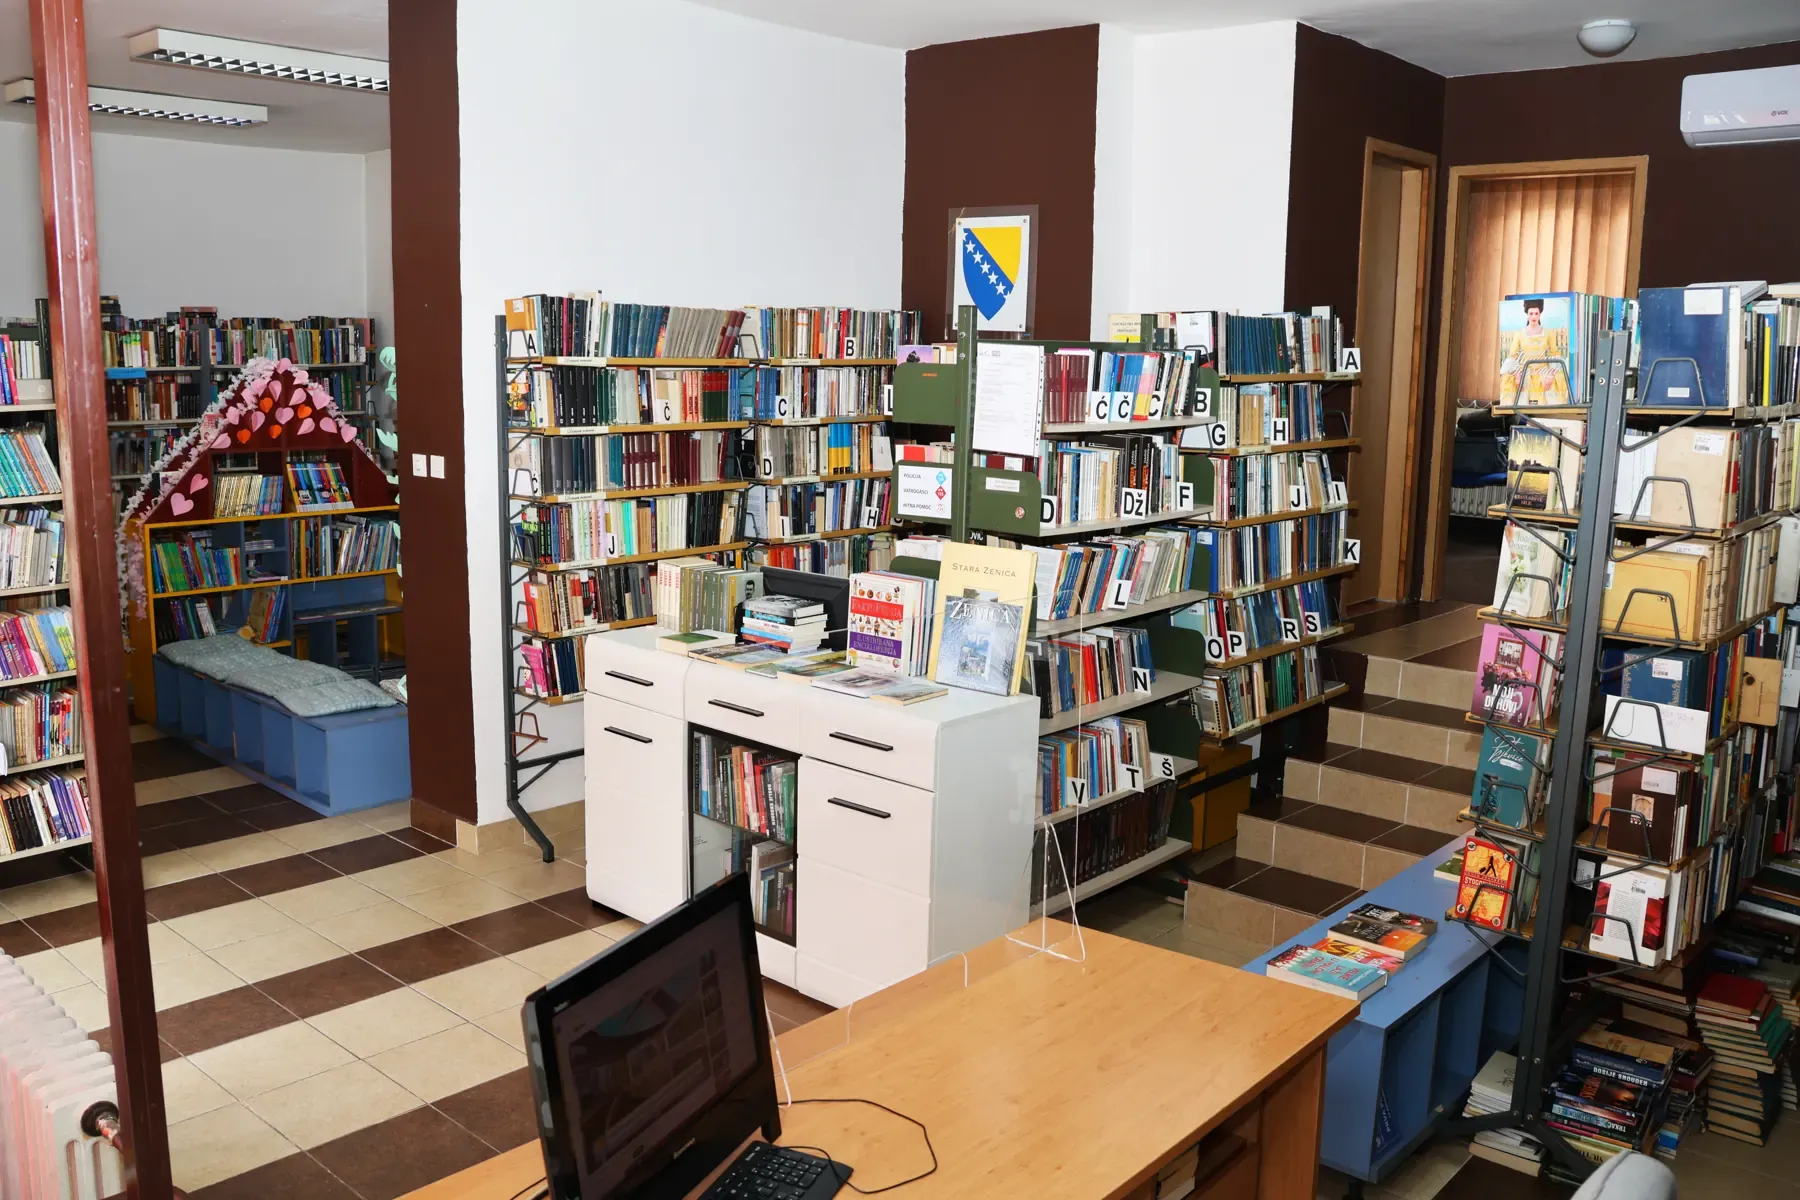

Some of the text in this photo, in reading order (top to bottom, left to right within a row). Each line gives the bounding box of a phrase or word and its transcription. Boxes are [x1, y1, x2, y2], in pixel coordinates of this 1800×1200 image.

[528, 333, 537, 354] A
[846, 340, 854, 356] B
[1344, 350, 1359, 370] A
[664, 402, 671, 420] Č
[778, 398, 787, 416] C
[1096, 396, 1108, 419] Ć
[1118, 396, 1130, 418] Č
[1149, 394, 1160, 416] C
[1194, 391, 1207, 412] B
[1212, 424, 1226, 446] G
[1273, 421, 1286, 441] H
[764, 459, 772, 476] D
[1179, 486, 1190, 507] F
[1291, 488, 1300, 507] J
[1334, 484, 1341, 500] I
[1040, 498, 1054, 523] D
[1124, 492, 1143, 516] Dž
[868, 510, 877, 526] H
[608, 536, 614, 555] J
[1345, 541, 1357, 560] K
[952, 562, 1016, 578] STARA ZENICA
[1114, 583, 1125, 606] L
[950, 600, 1010, 624] ZENICA
[1283, 621, 1297, 640] R
[1306, 614, 1318, 633] S
[853, 641, 897, 656] ENCIKLOPEDIJA
[856, 635, 894, 648] ILUSTRIRANA
[1208, 639, 1222, 659] O
[1229, 634, 1242, 653] P
[1134, 671, 1147, 691] N
[1492, 684, 1514, 699] MOJI
[1162, 757, 1173, 777] Š
[1126, 768, 1139, 788] T
[1072, 781, 1085, 804] V
[1593, 1066, 1616, 1079] DOSIJE
